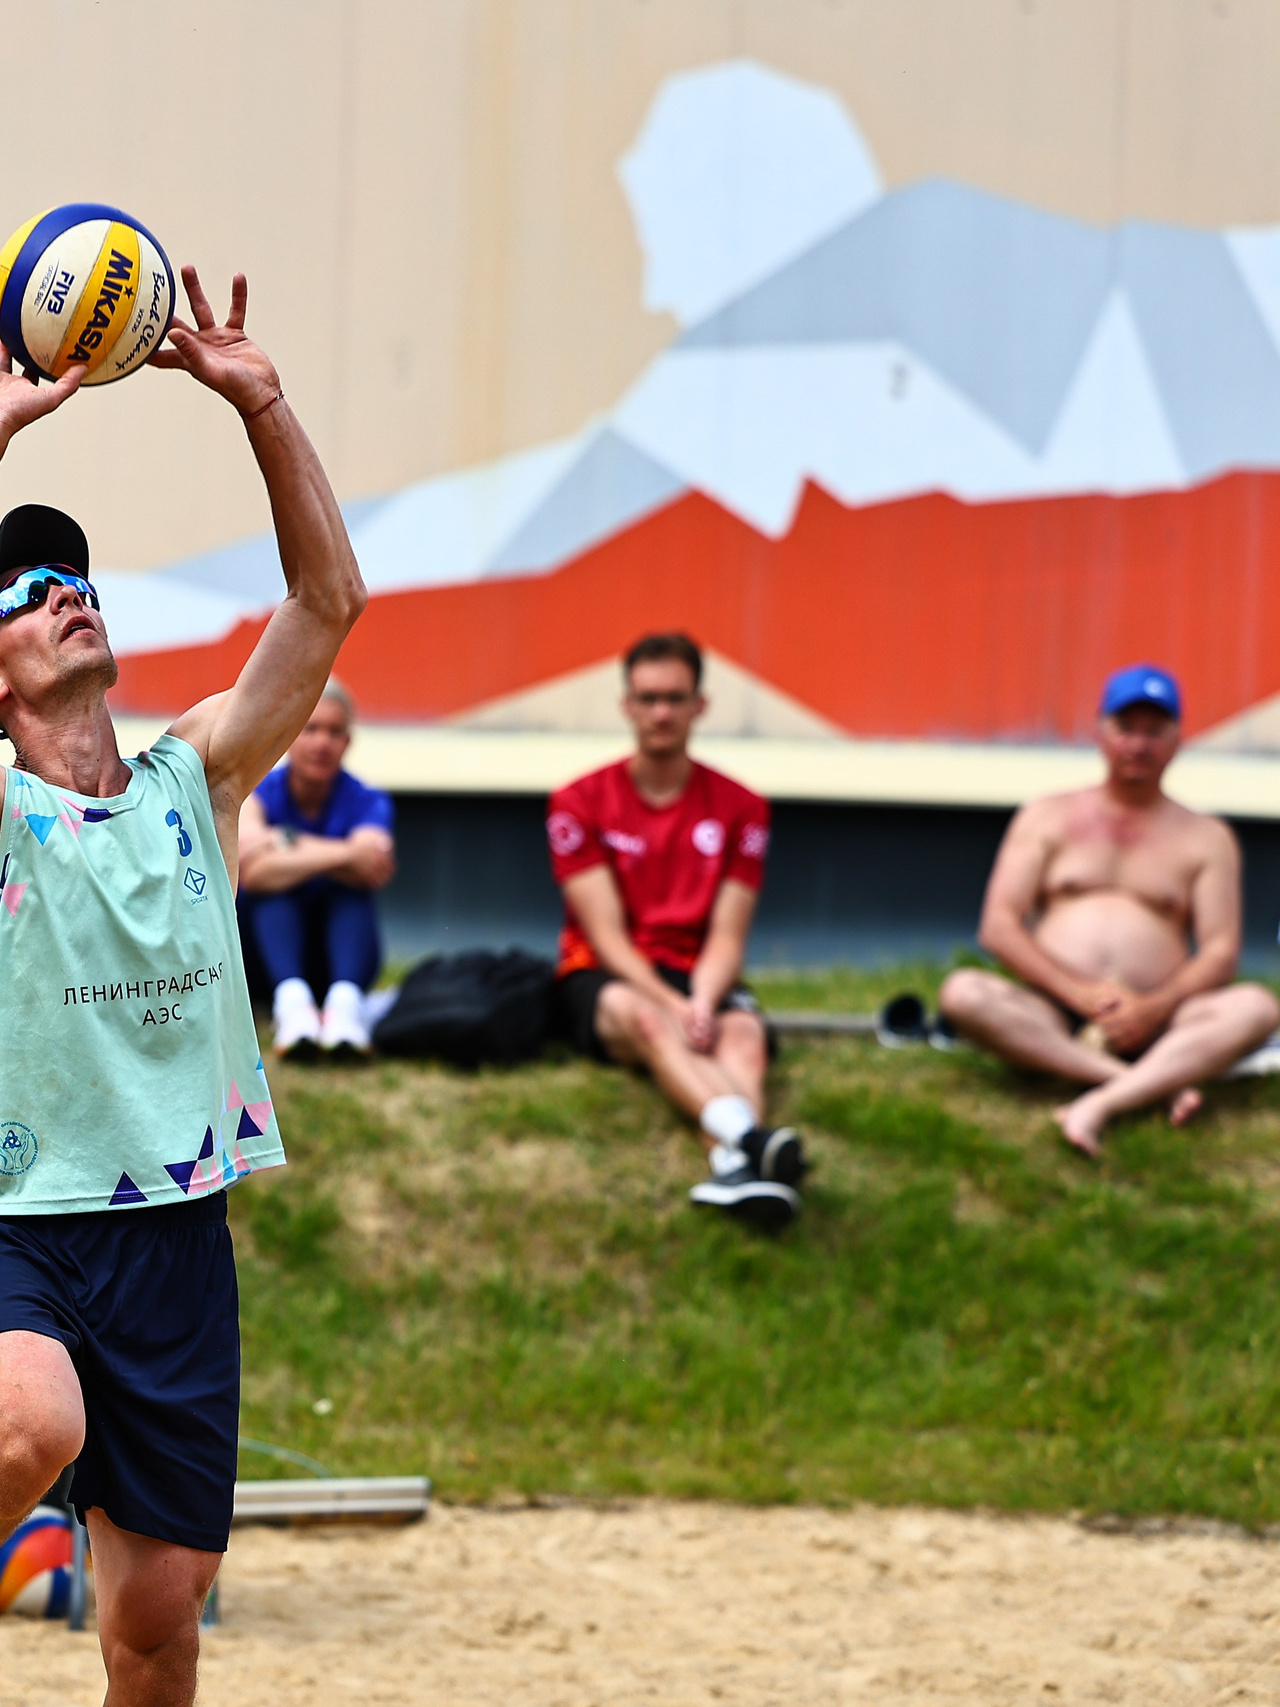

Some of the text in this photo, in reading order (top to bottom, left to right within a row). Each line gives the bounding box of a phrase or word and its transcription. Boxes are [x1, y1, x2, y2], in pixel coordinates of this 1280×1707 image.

[47, 270, 76, 315] FIVB
[66, 248, 134, 362] MIKASA
[165, 808, 193, 857] 3
[142, 1003, 183, 1026] АЭС
